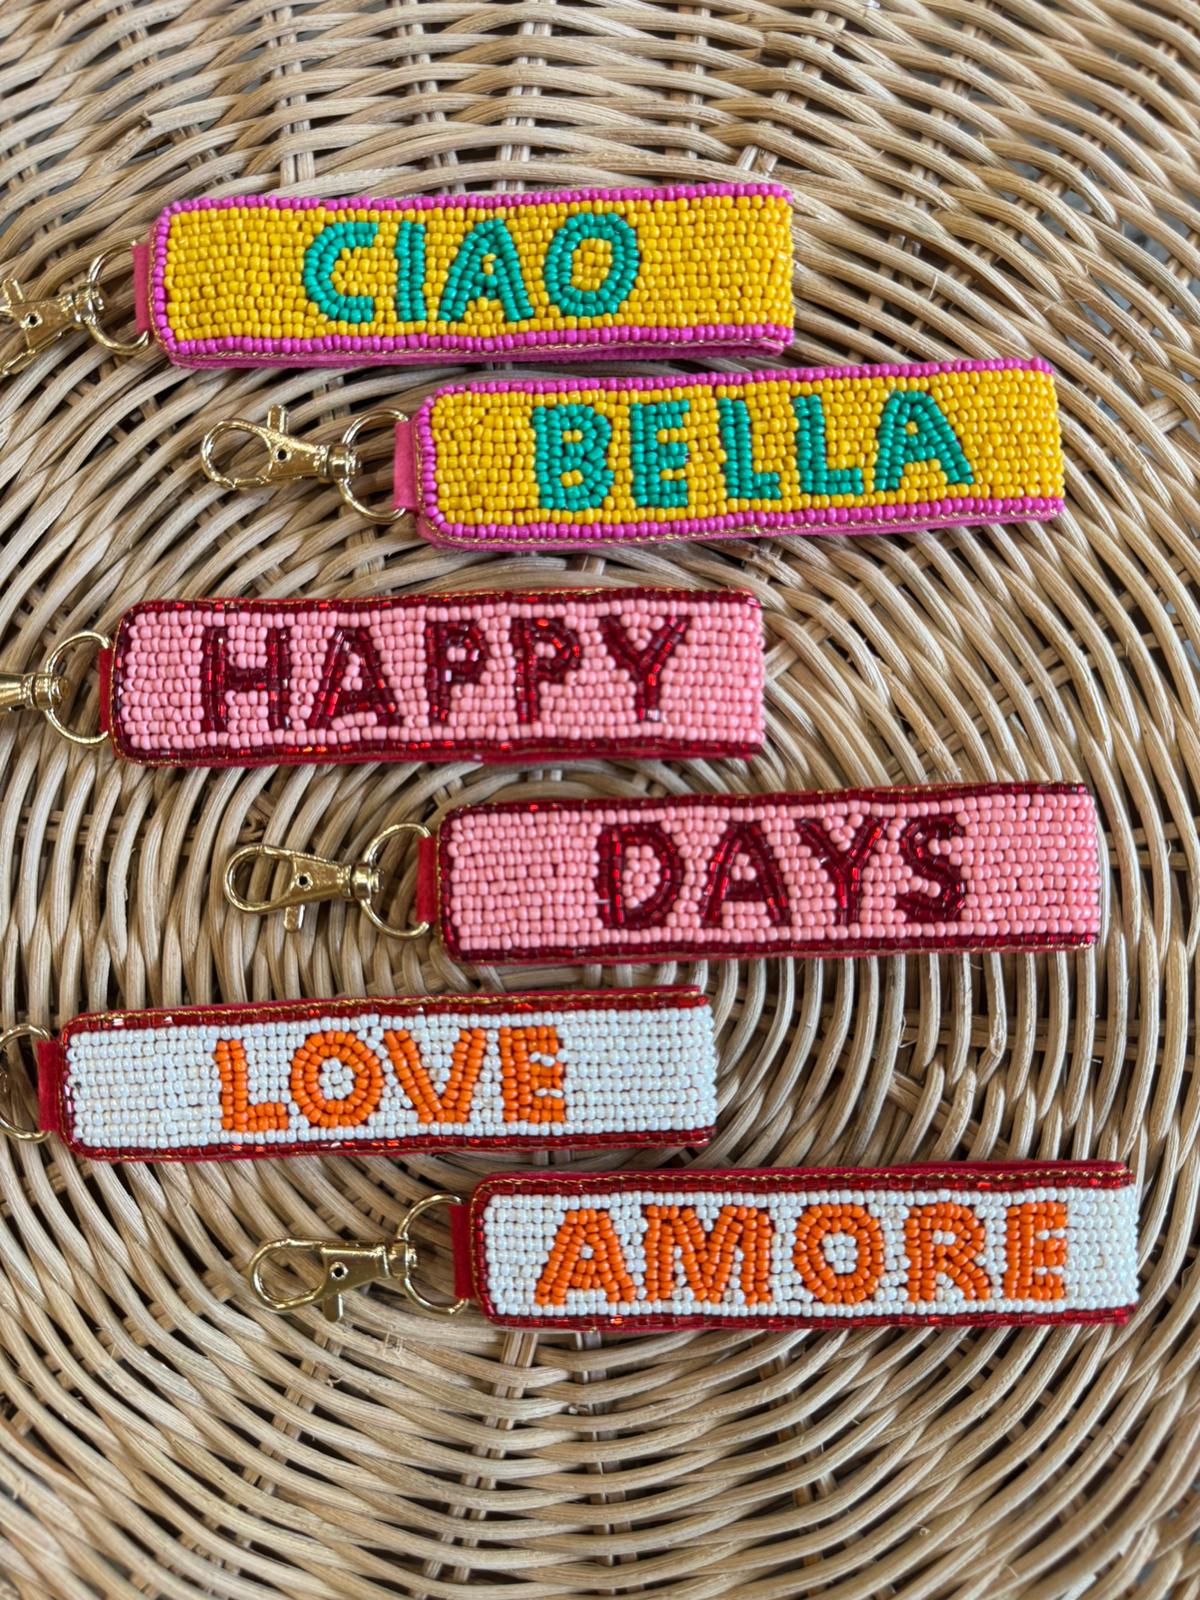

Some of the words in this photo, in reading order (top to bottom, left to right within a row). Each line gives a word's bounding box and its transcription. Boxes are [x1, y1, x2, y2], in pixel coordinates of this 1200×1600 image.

[303, 212, 640, 323] CIAO
[531, 390, 974, 510] BELLA
[201, 612, 690, 733] HAPPY
[595, 814, 967, 930] DAYS
[216, 1024, 565, 1132] LOVE
[537, 1201, 1067, 1305] AMORE
